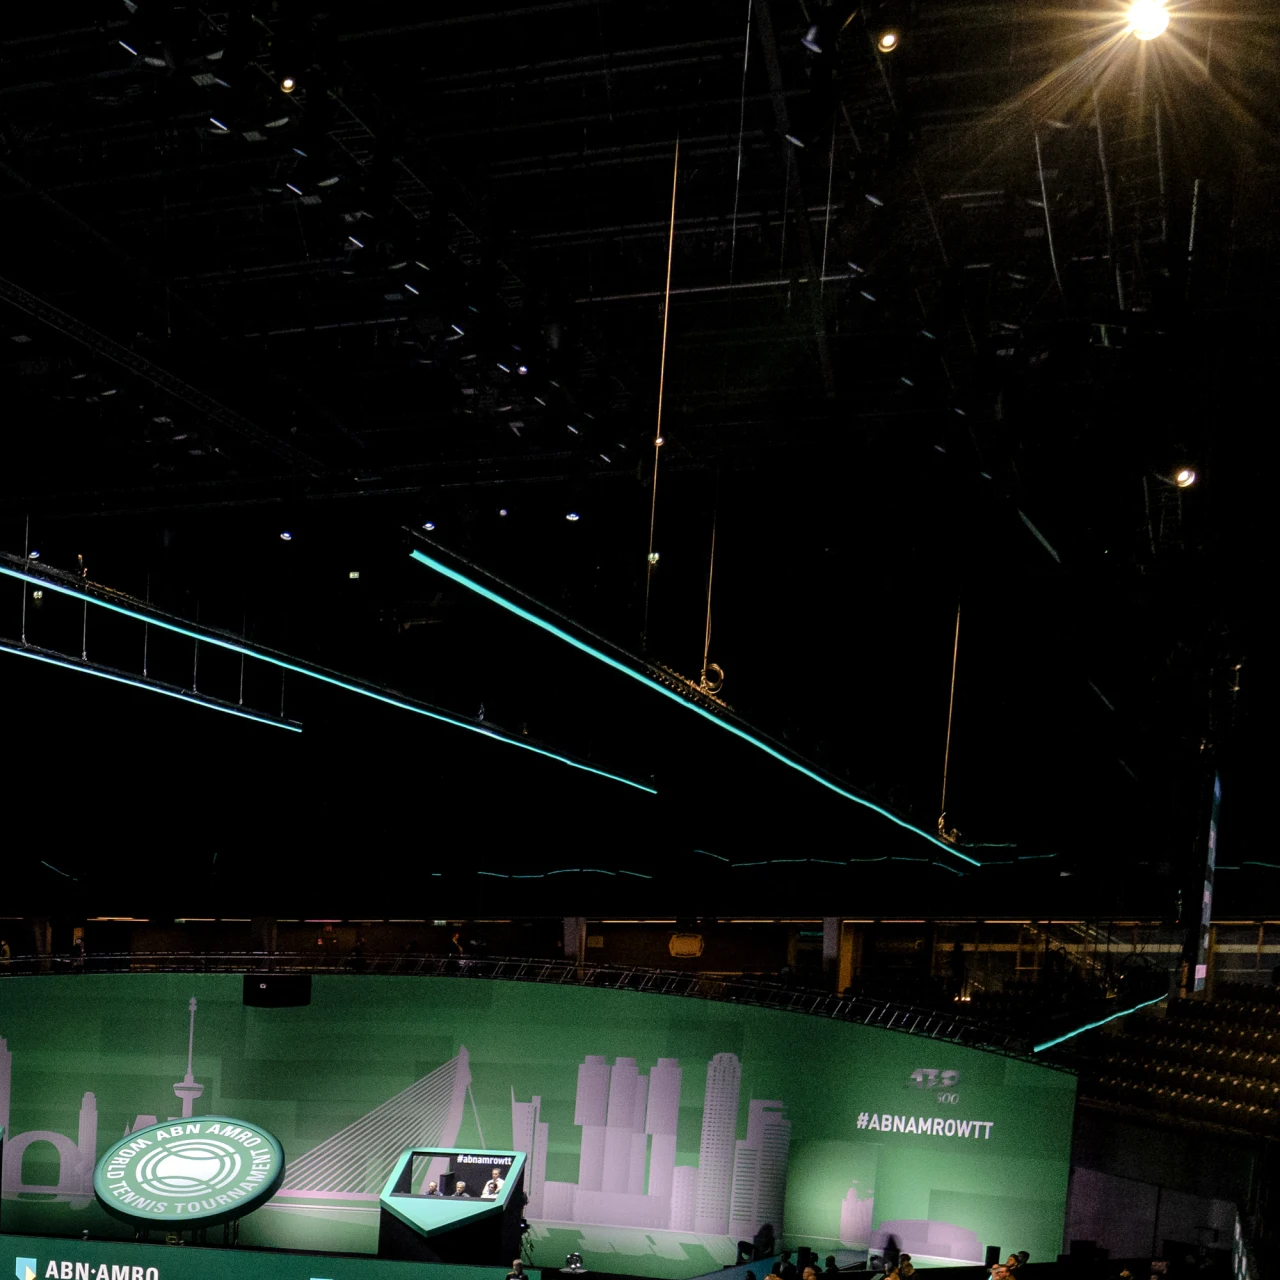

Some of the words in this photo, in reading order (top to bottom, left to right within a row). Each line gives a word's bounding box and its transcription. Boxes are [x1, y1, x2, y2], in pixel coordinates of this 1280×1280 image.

[156, 1123, 200, 1142] ABN
[205, 1124, 262, 1148] AMRO
[856, 1112, 994, 1139] #ABNAMROWTT
[106, 1138, 152, 1179] WORLD
[457, 1154, 512, 1165] #abnamrowtt
[174, 1149, 271, 1214] TOURNAMENT
[109, 1180, 168, 1214] TENNIS
